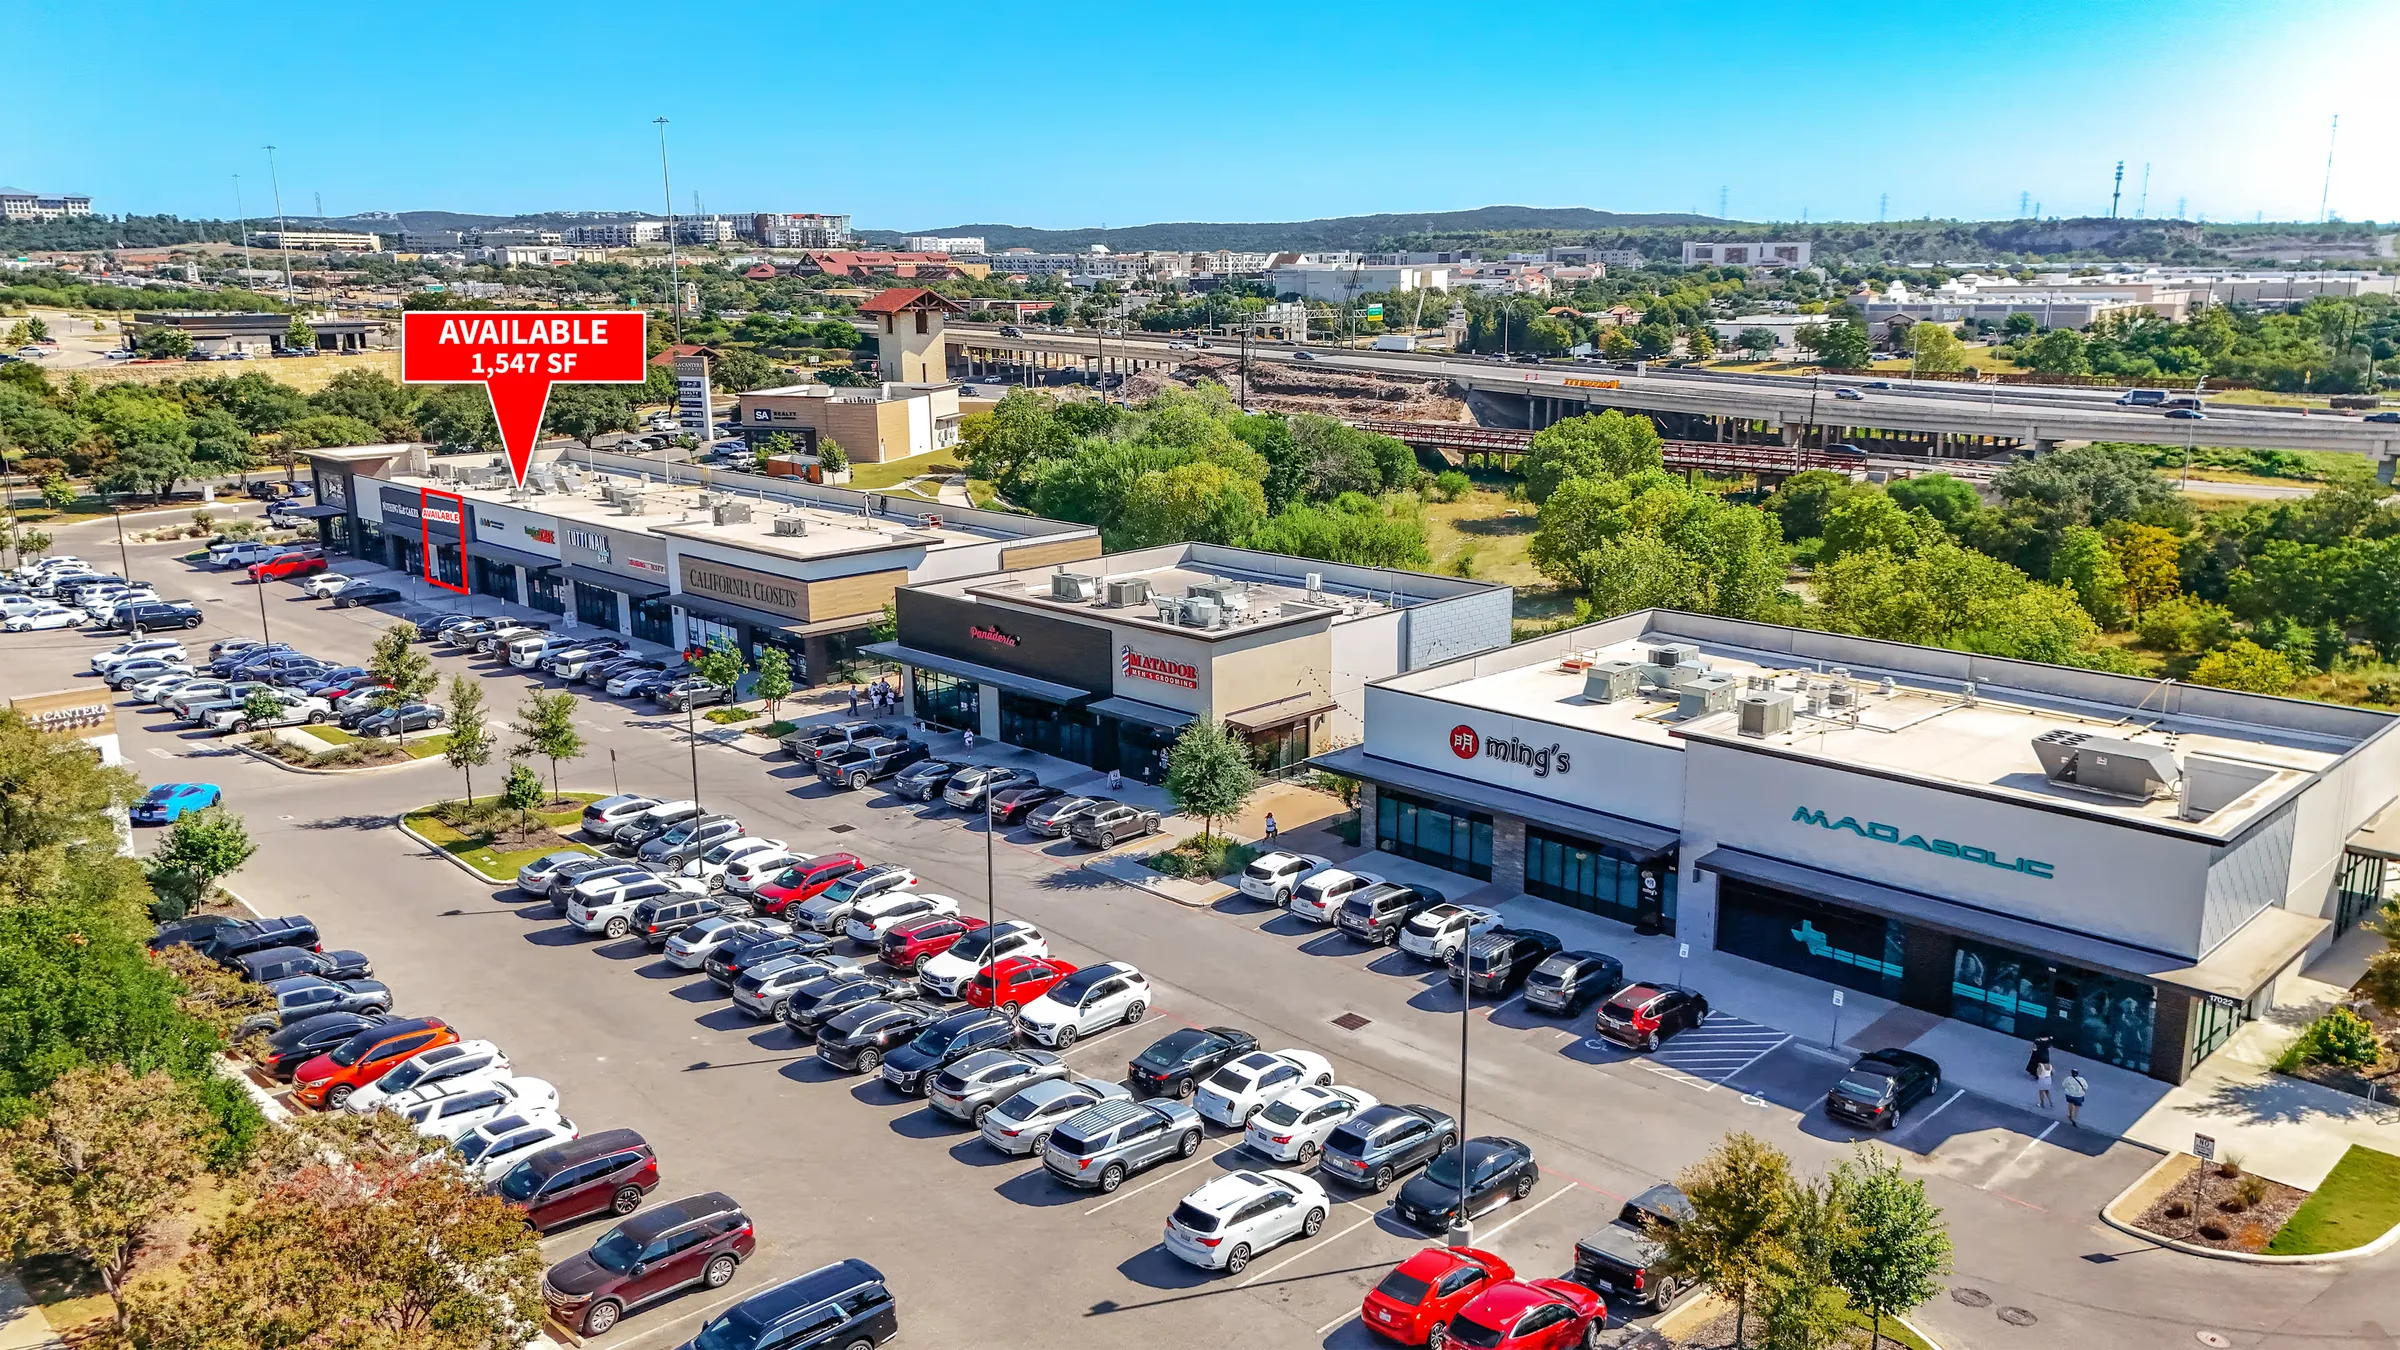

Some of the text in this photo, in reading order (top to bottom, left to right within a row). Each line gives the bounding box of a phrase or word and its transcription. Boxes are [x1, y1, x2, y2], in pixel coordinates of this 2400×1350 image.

[755, 411, 769, 420] SA
[690, 569, 797, 608] CALIFORNIA CLOSETS
[1130, 653, 1197, 679] MATADOR
[1132, 669, 1193, 688] MEN'S GROOMING
[42, 704, 110, 722] CANTERA
[1454, 733, 1474, 753] 明
[1485, 736, 1570, 778] ming's
[1791, 806, 2055, 880] MADABOLIC
[2209, 995, 2234, 1006] 17022
[2200, 1138, 2210, 1148] NO
